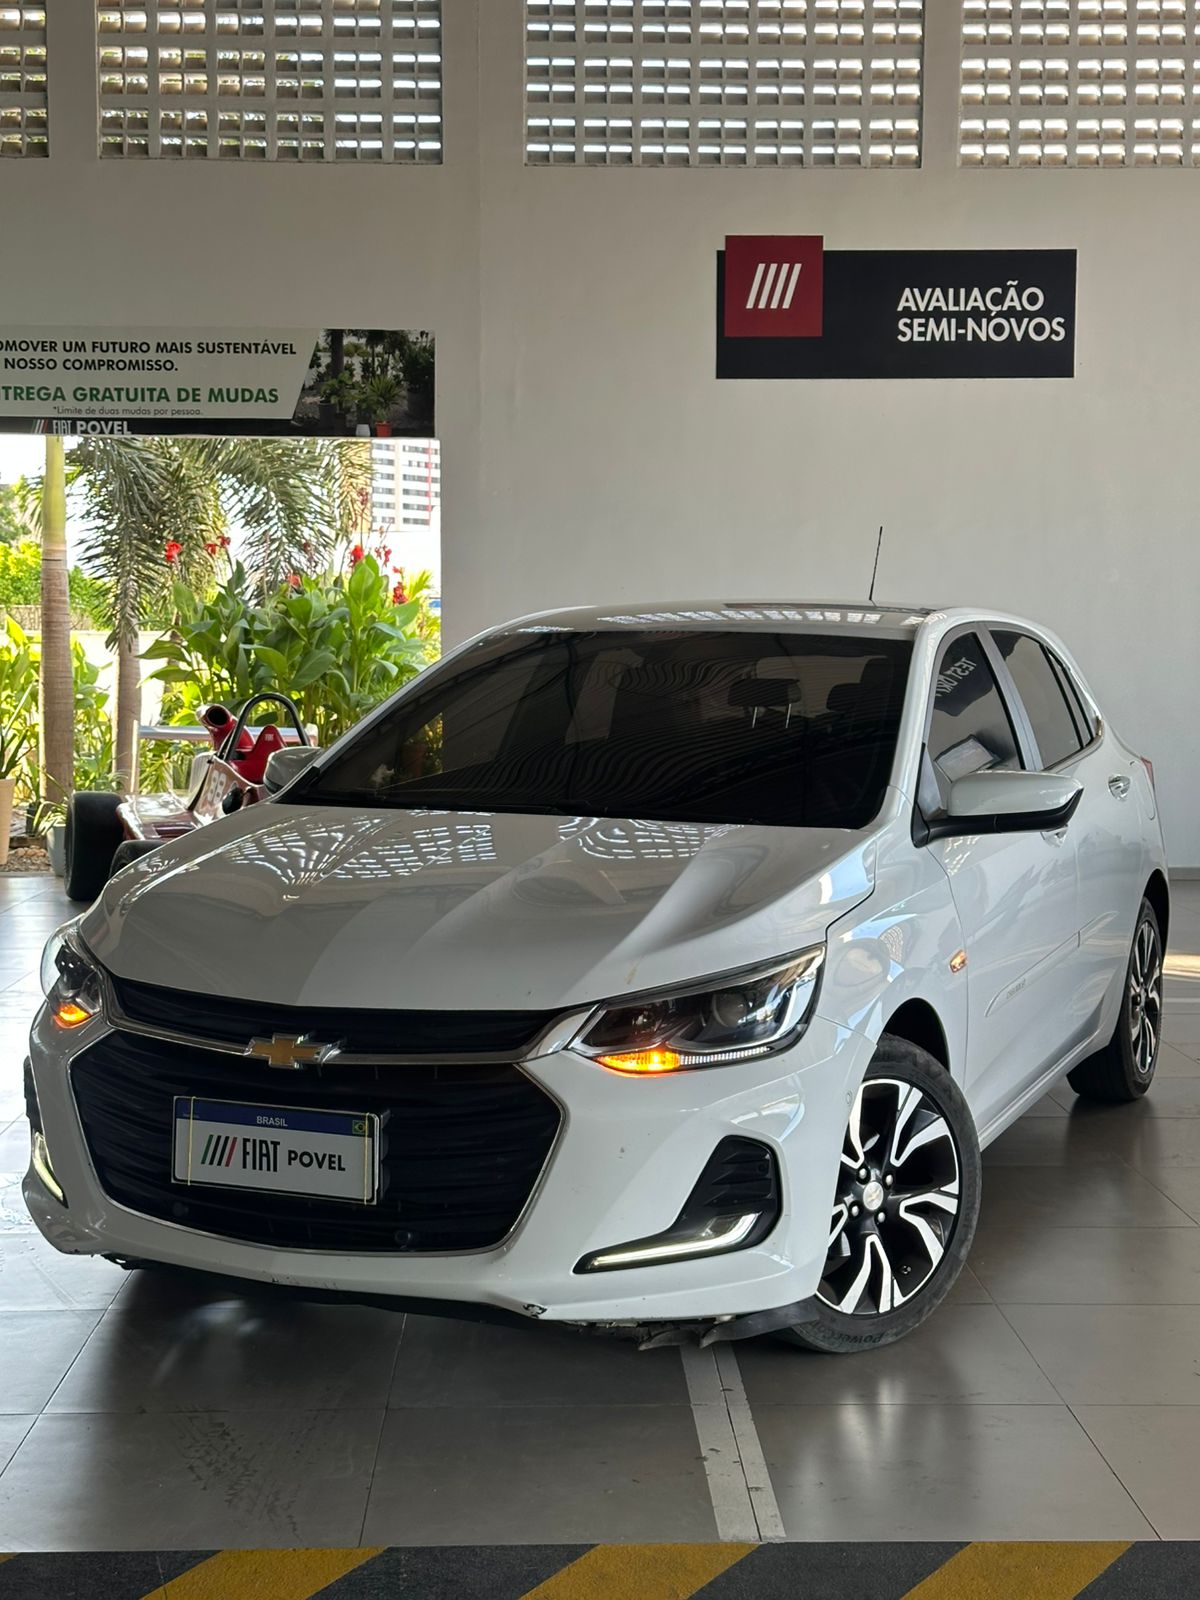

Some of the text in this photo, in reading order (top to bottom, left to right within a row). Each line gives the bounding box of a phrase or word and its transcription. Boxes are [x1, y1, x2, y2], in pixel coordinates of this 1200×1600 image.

[897, 280, 1044, 317] AVALIAÇÃO
[897, 317, 1066, 342] SEMI-NOVOS
[63, 341, 87, 353] UM
[92, 341, 151, 353] FUTURO
[155, 342, 192, 354] MAIS
[197, 340, 296, 355] SUSTENTÁVEL
[4, 358, 178, 371] NOSSO COMPROMISSO.
[73, 386, 170, 402] GRATUITA
[177, 388, 201, 403] DE
[207, 388, 279, 403] MUDAS
[85, 406, 96, 415] de
[99, 407, 119, 415] duas
[122, 407, 151, 415] mudas
[153, 408, 168, 418] por
[52, 420, 132, 435] FIAT POVEL
[256, 1115, 289, 1127] BRASIL
[242, 1137, 346, 1173] FIAT POVEL
